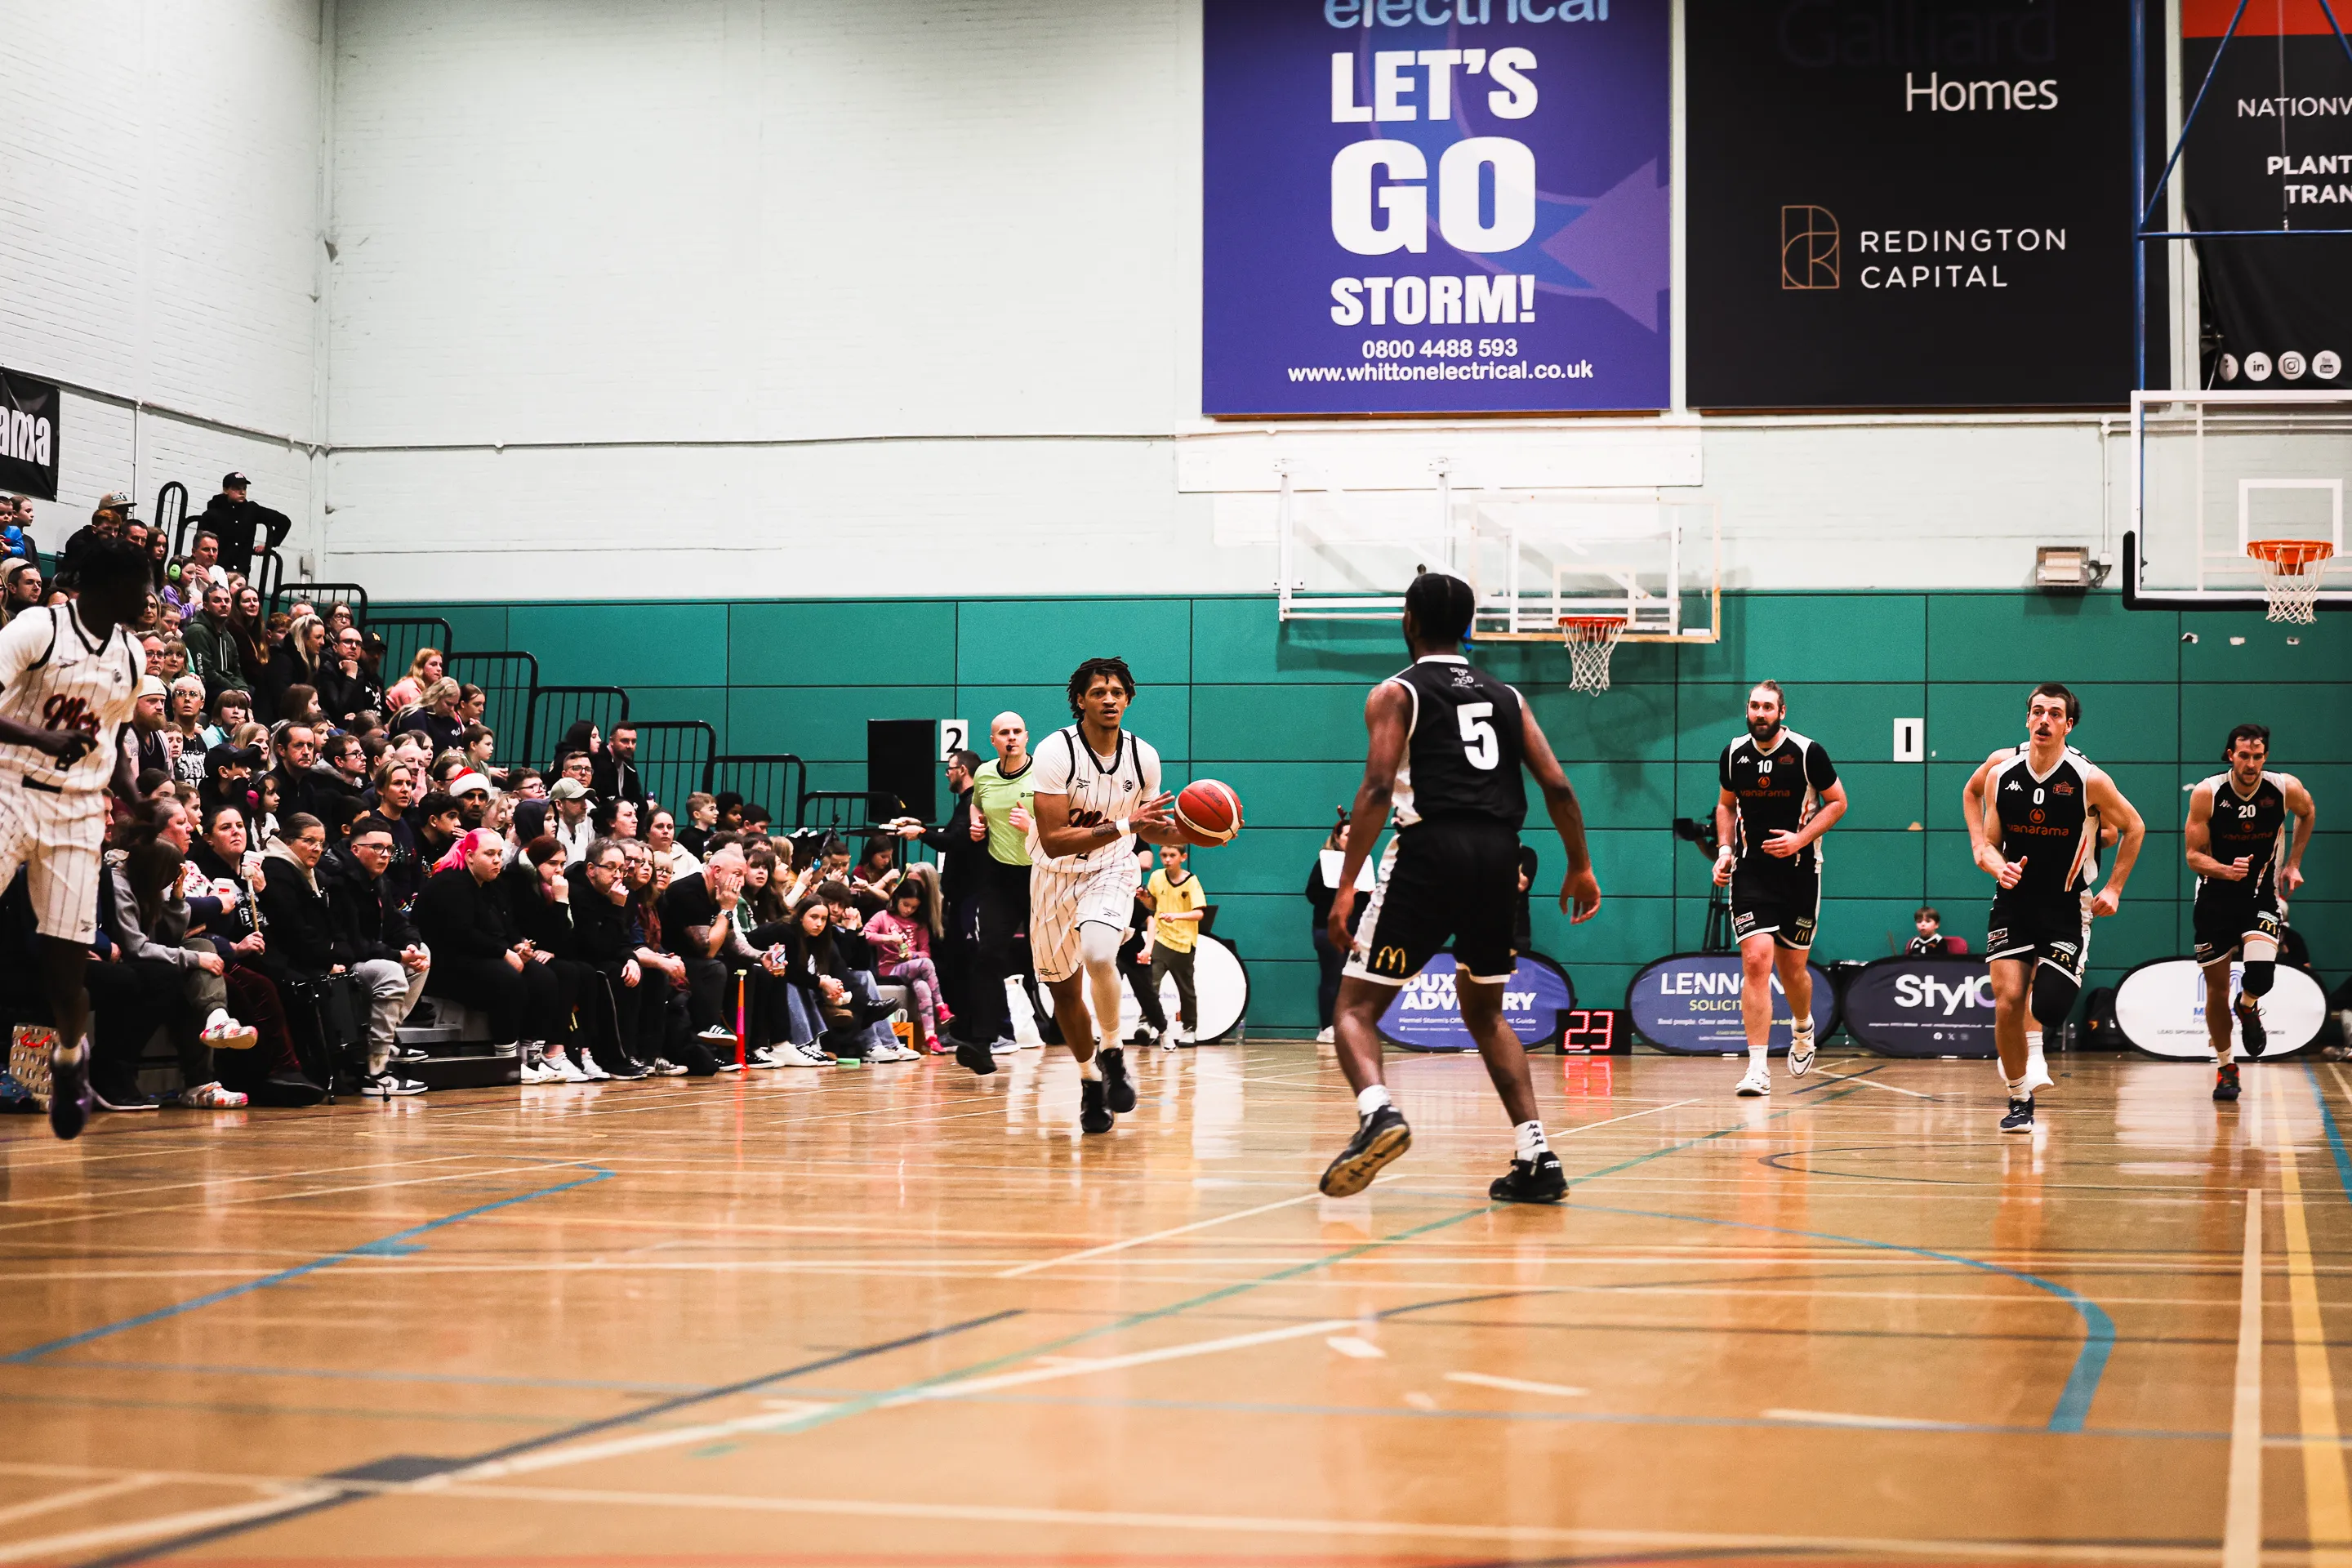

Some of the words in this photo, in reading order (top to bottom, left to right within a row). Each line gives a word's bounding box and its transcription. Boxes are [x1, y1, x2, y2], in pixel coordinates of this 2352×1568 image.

[1324, 0, 1608, 28] electrical
[1331, 47, 1539, 123] LET'S
[1906, 72, 2059, 112] Homes
[2267, 155, 2352, 175] PLANT
[1331, 136, 1536, 256] GO
[2284, 185, 2352, 203] TRAN
[1860, 229, 2066, 253] REDINGTON
[1860, 265, 2007, 289] CAPITAL
[1330, 274, 1536, 326] STORM!
[1361, 340, 1414, 359] 0800
[1419, 339, 1472, 358] 4488
[1478, 338, 1518, 357] 593
[1288, 359, 1593, 382] www.whittonelectrical.co.uk
[946, 727, 963, 754] 2
[1457, 702, 1499, 770] 5
[1757, 760, 1773, 773] 10
[1740, 789, 1791, 798] vanarama
[2033, 787, 2045, 804] 0
[2238, 804, 2256, 818] 20
[2007, 823, 2070, 836] vanarama
[1401, 973, 1457, 992] DUX
[1660, 972, 1786, 996] LENNN
[1400, 991, 1538, 1011] ADVRY
[1563, 1010, 1615, 1051] 23
